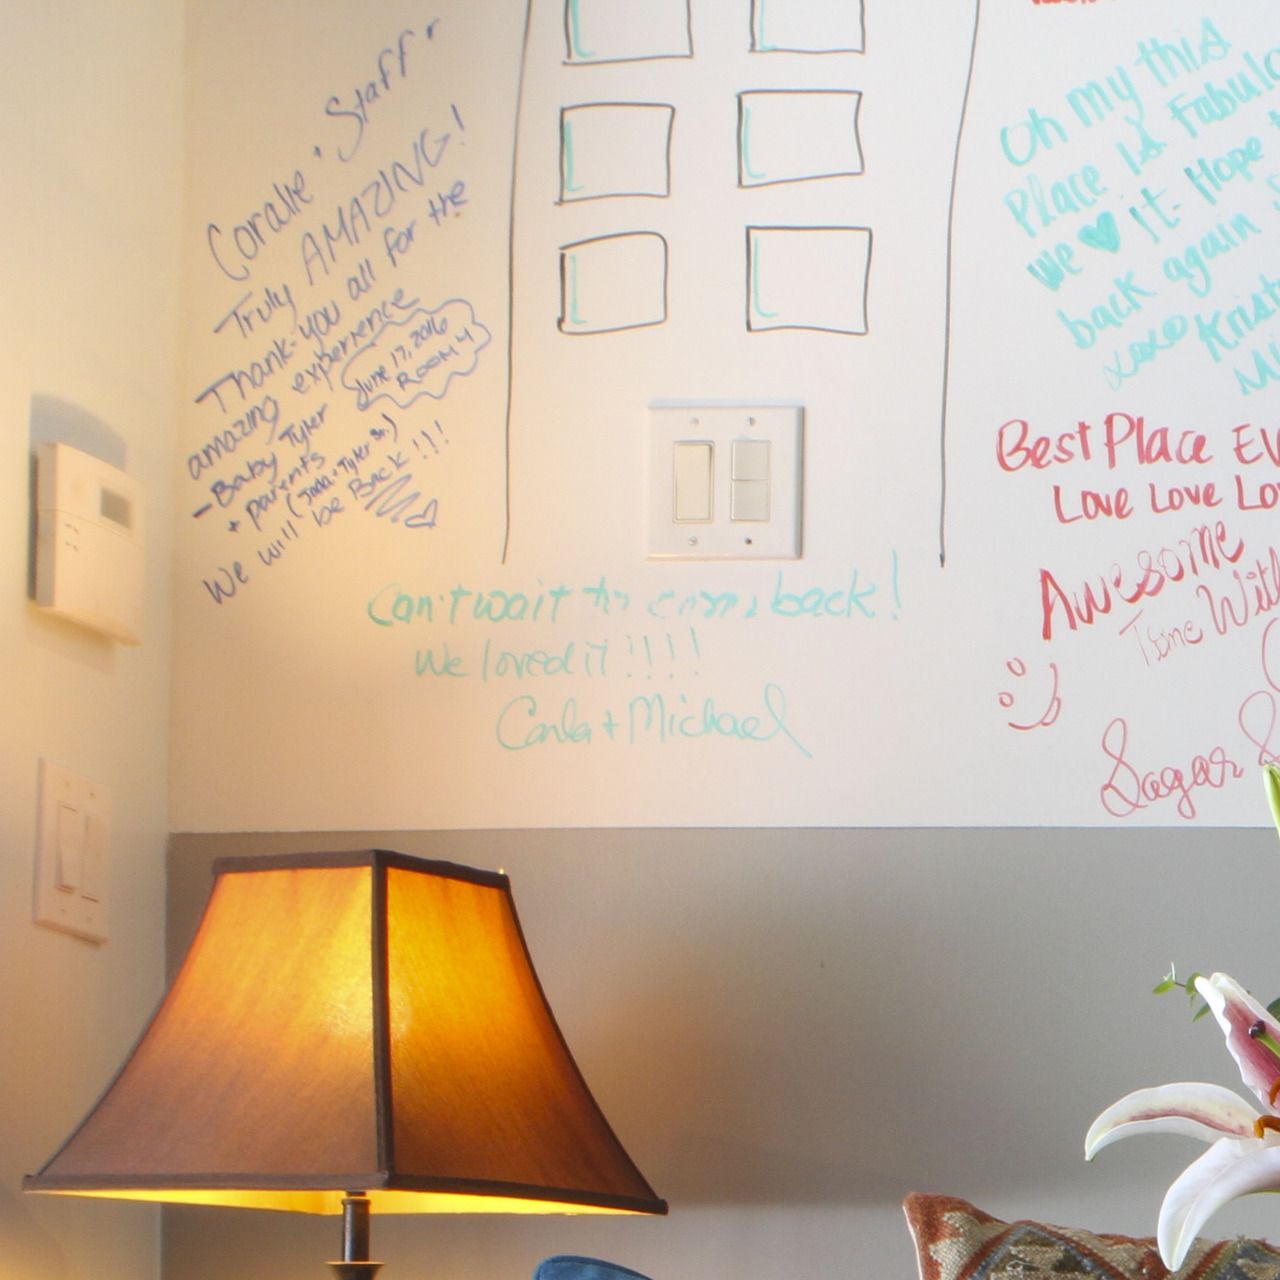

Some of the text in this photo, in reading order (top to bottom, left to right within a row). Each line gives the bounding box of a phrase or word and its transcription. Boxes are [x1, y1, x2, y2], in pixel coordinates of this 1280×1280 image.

[1000, 107, 1068, 166] Oh
[348, 178, 470, 301] all for the
[1057, 213, 1262, 349] back again
[188, 395, 279, 479] amazing
[996, 418, 1092, 473] Best
[1103, 412, 1214, 469] Place
[1053, 485, 1133, 524] Love
[1149, 481, 1223, 513] Love
[472, 549, 901, 625] wait back!
